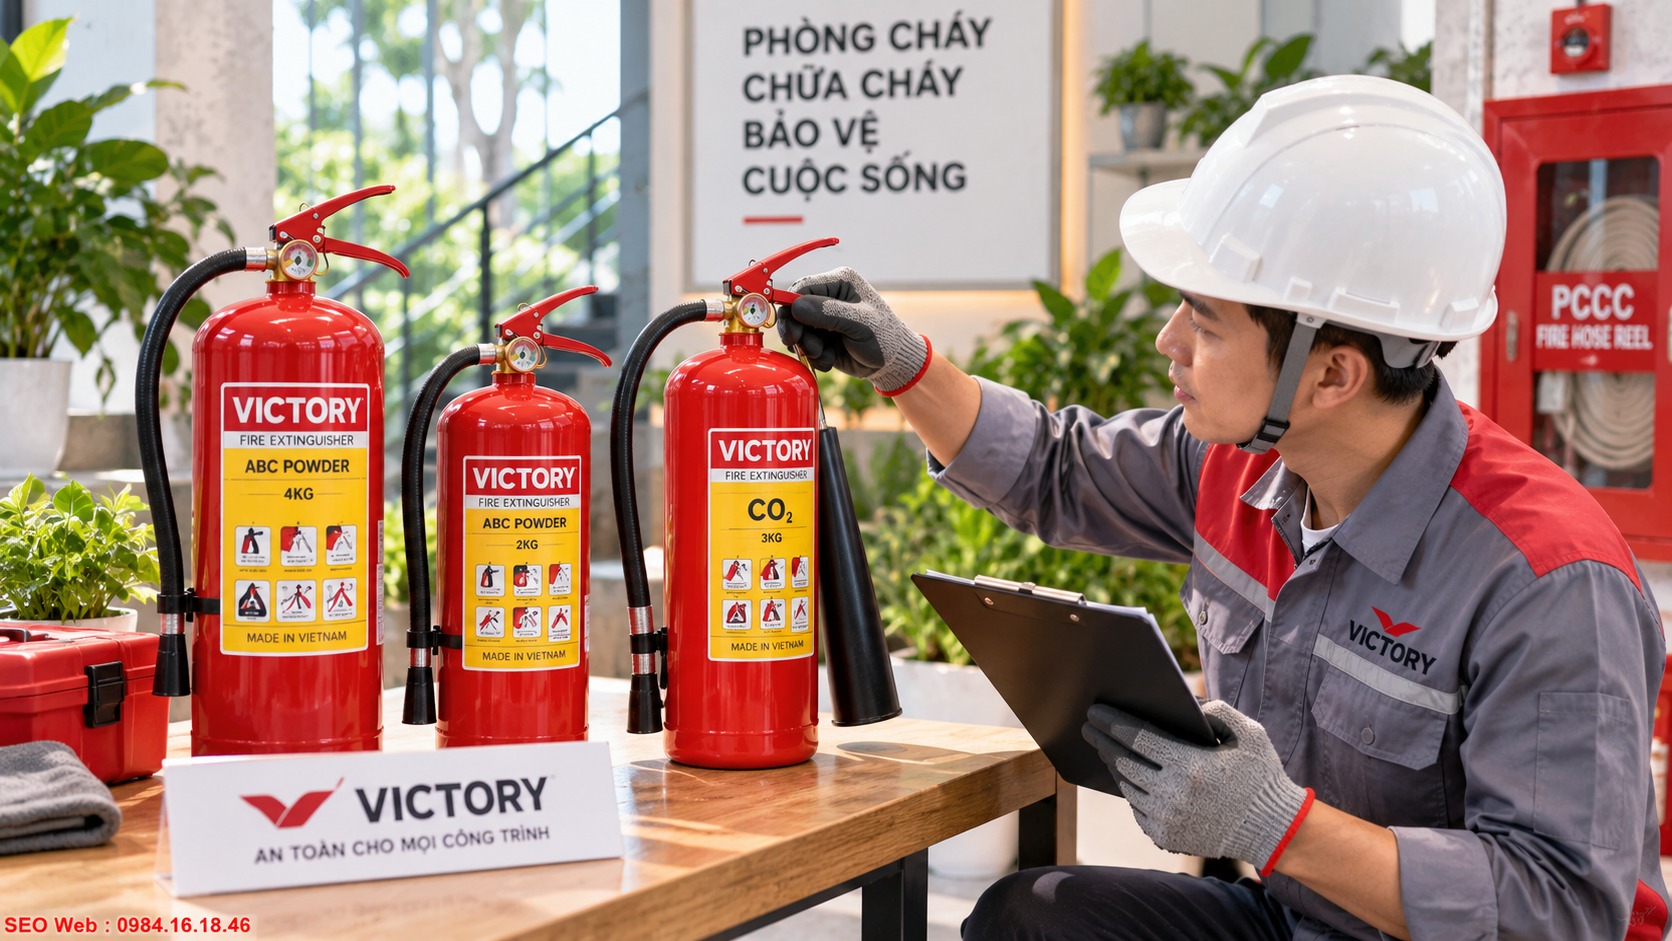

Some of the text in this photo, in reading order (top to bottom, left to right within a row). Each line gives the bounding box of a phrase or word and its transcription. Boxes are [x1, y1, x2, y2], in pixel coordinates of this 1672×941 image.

[743, 9, 992, 56] PHÒNG CHÁY
[743, 59, 963, 101] CHỮA CHÁY
[744, 109, 879, 154] BẢO VỆ
[743, 150, 967, 202] CUỘC SỐNG
[1552, 283, 1634, 321] PCCC
[1536, 324, 1653, 350] FIRE HOSE REEL
[232, 396, 361, 424] VICTORY
[240, 435, 354, 446] FIRE EXTINGUISHER
[718, 439, 812, 462] VICTORY
[245, 460, 350, 473] ABC POWDER
[725, 471, 746, 480] FIRE
[472, 467, 576, 489] VICTORY
[284, 488, 314, 500] 4KG
[478, 497, 570, 507] FIRE EXTINGUISHER
[482, 517, 567, 529] ABC POWDER
[516, 540, 538, 550] 2KG
[761, 533, 782, 543] 3KG
[247, 631, 347, 643] MADE IN VIETNAM
[731, 640, 804, 652] MADE IN VIETNAM
[1349, 619, 1437, 675] VICTORY
[482, 650, 566, 661] MADE IN VIETNAM
[355, 777, 547, 823] VICTORY
[255, 824, 550, 864] AN TOÀN CHO MỌI CÔNG TRÌNH
